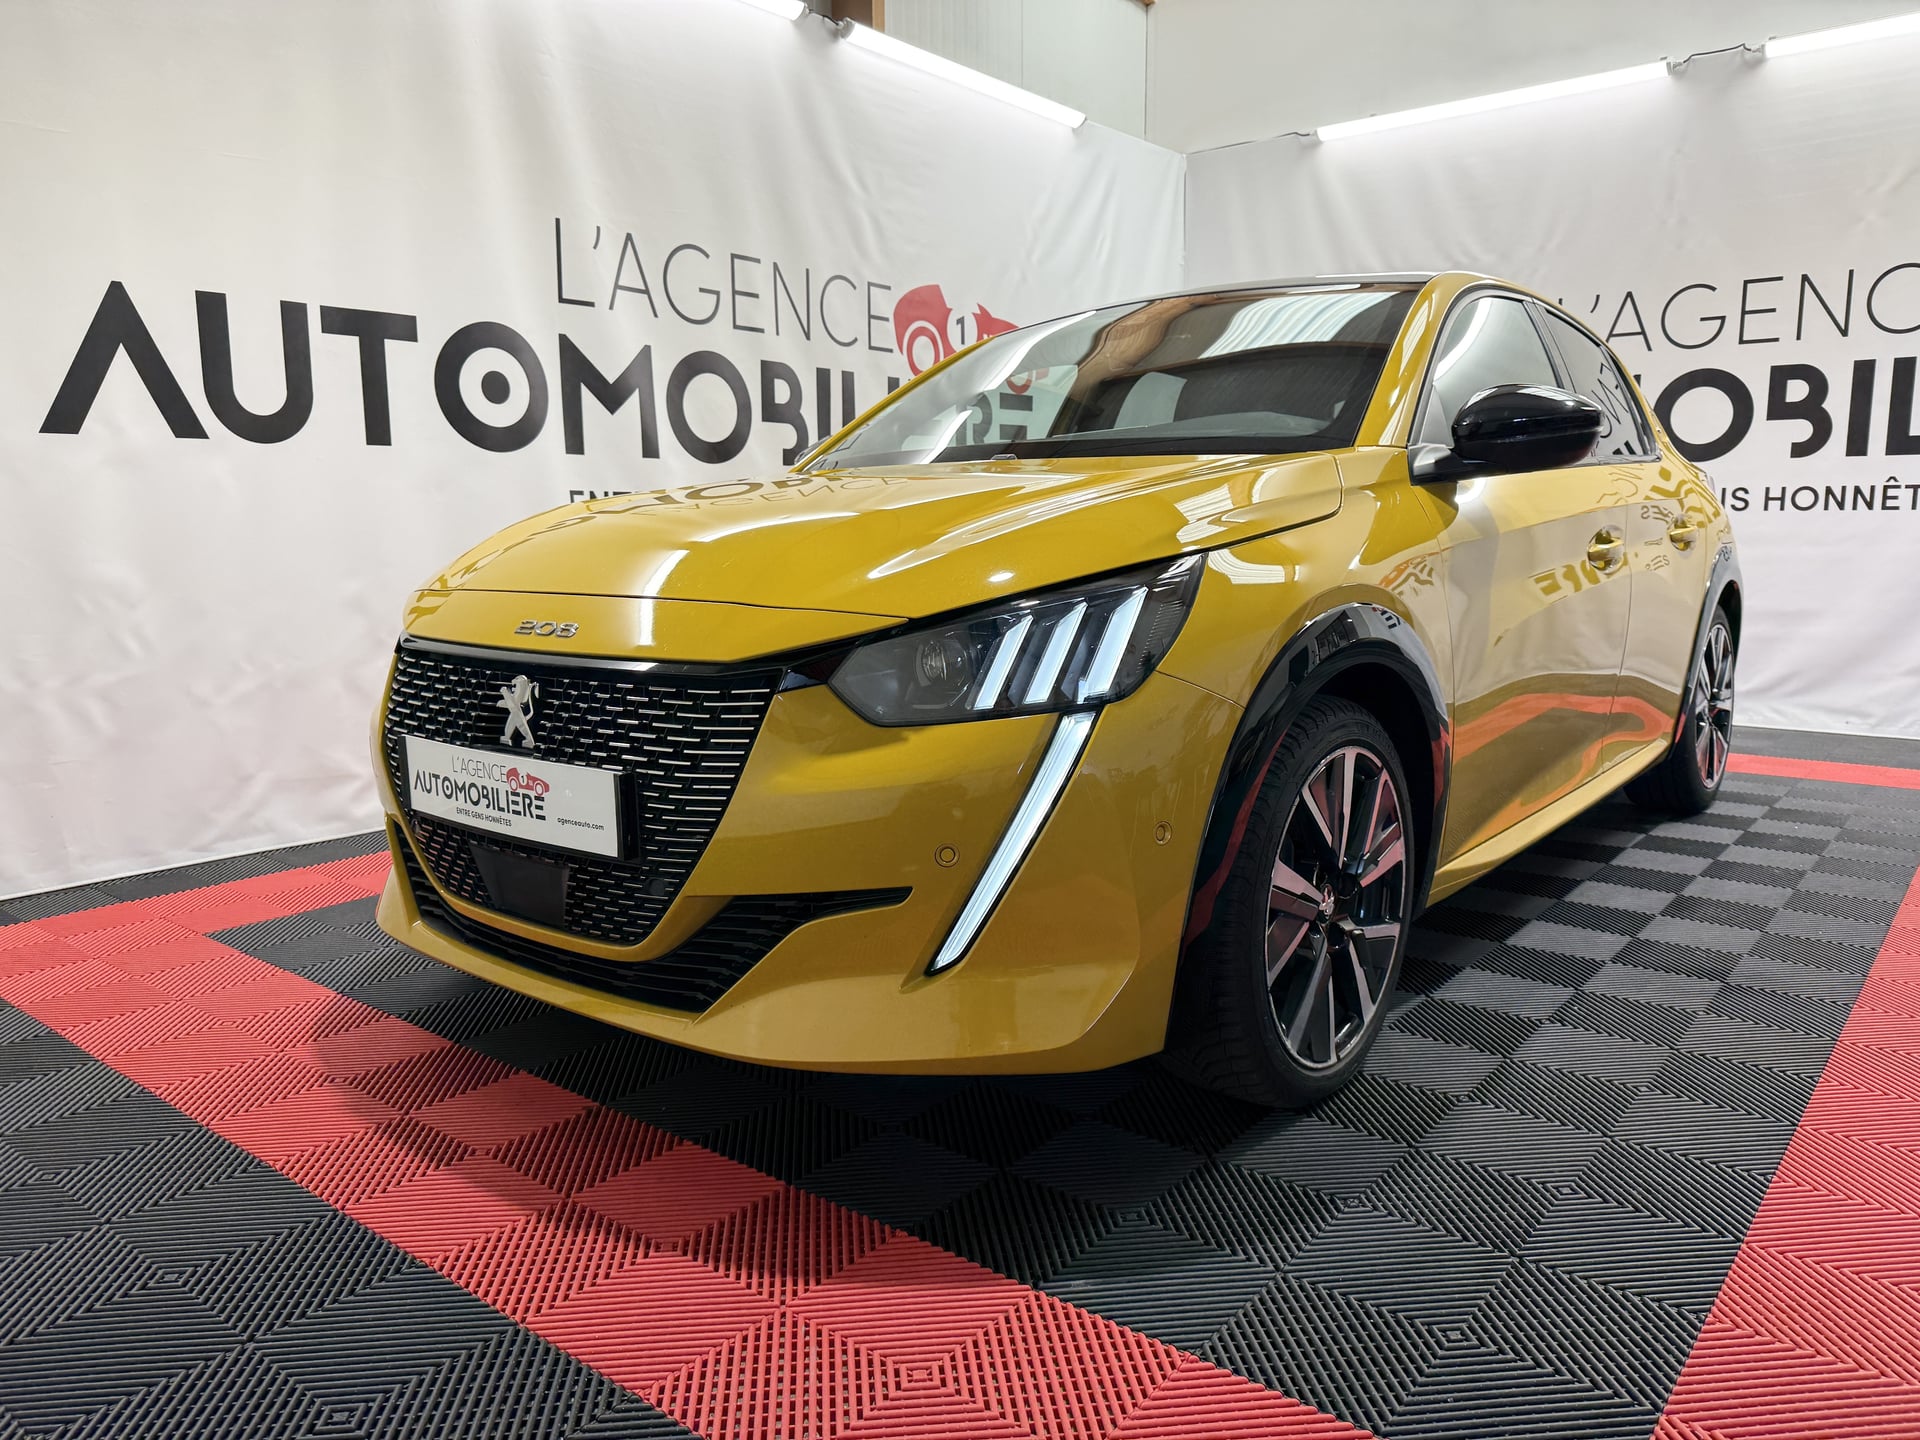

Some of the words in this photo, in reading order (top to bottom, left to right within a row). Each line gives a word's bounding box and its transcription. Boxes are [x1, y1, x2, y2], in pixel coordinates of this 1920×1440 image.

[555, 217, 894, 353] L'AGENCE
[1558, 262, 1920, 351] 'AGENC
[514, 619, 580, 638] 208
[451, 755, 508, 784] L'AGENCE
[471, 810, 485, 821] GENS
[556, 816, 605, 831] agenceauto.com
